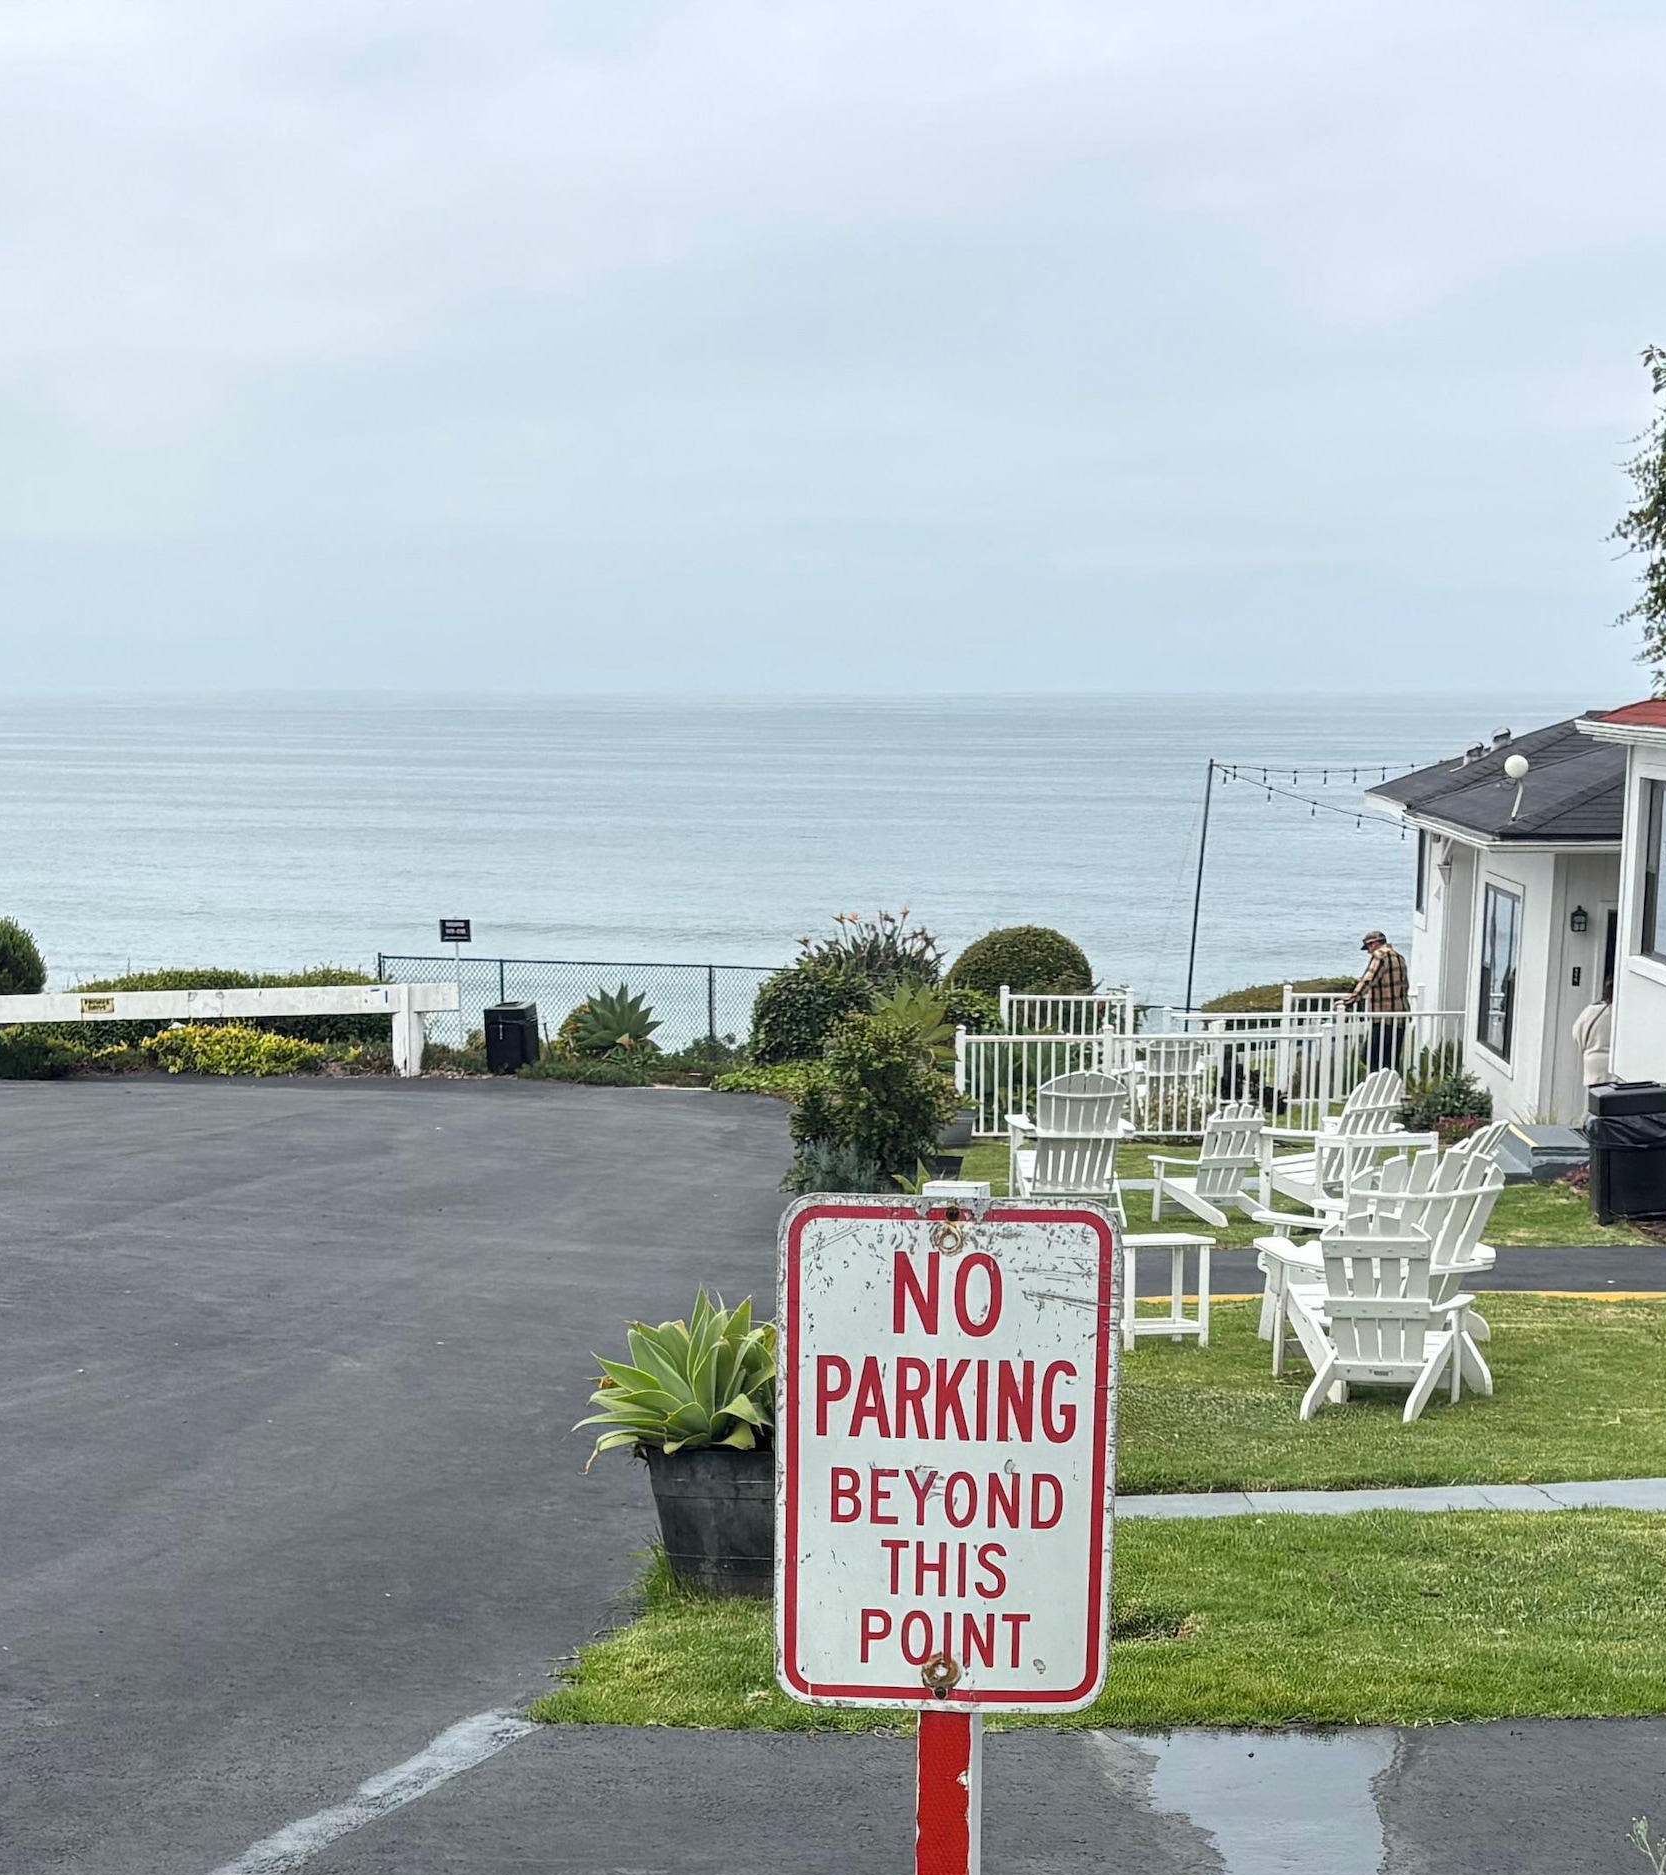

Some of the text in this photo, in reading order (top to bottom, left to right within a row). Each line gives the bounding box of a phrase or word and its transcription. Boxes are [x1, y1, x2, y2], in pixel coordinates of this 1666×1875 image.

[892, 1250, 1004, 1337] NO
[815, 1354, 1079, 1445] PARKING
[830, 1466, 1064, 1530] BEYOND
[880, 1539, 1008, 1600] THIS
[859, 1608, 1032, 1669] POINT
